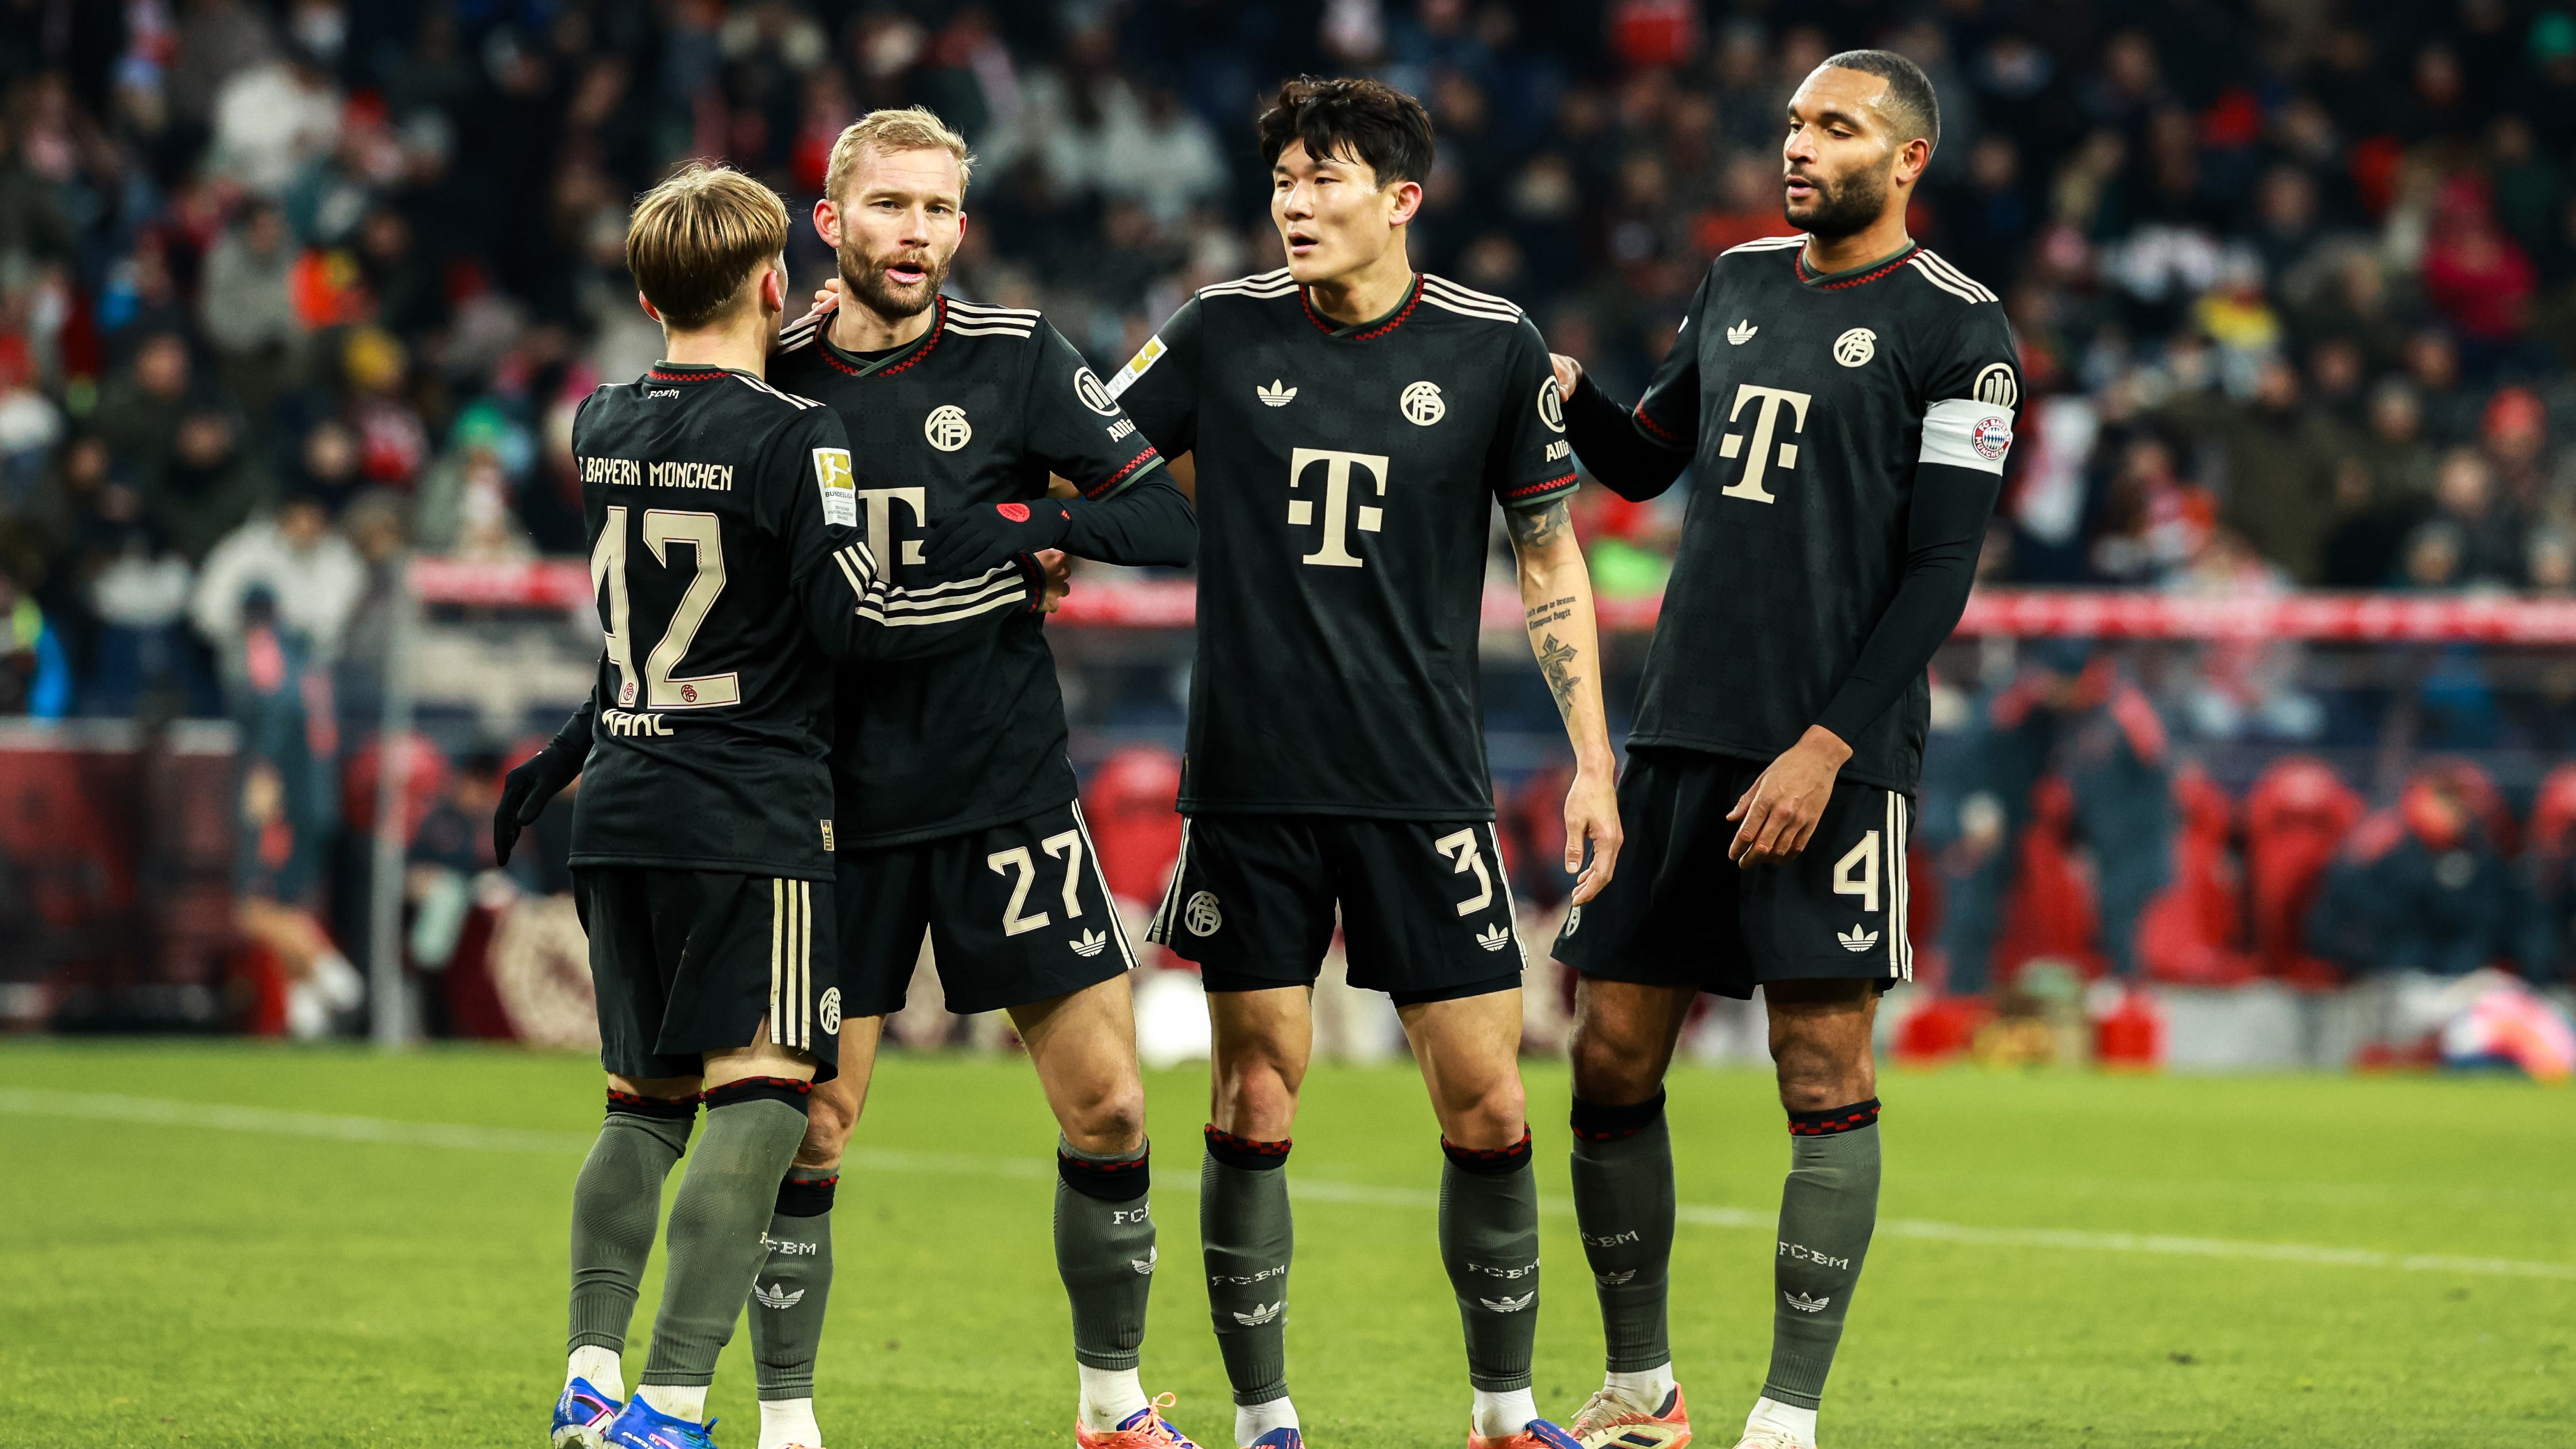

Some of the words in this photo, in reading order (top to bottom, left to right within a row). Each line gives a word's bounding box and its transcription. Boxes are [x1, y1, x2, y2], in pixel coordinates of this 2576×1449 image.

[647, 389, 680, 399] FCBM
[1978, 421, 1990, 431] FC
[586, 457, 641, 486] BAYERN
[648, 461, 733, 491] MÜNCHEN
[590, 505, 740, 709] 42
[987, 829, 1083, 937] 27
[1435, 828, 1493, 917] 3
[1833, 830, 1879, 912] 4
[1467, 1257, 1540, 1279] FCBM
[1779, 1241, 1849, 1270] FCBM
[1212, 1264, 1285, 1286] FCBM
